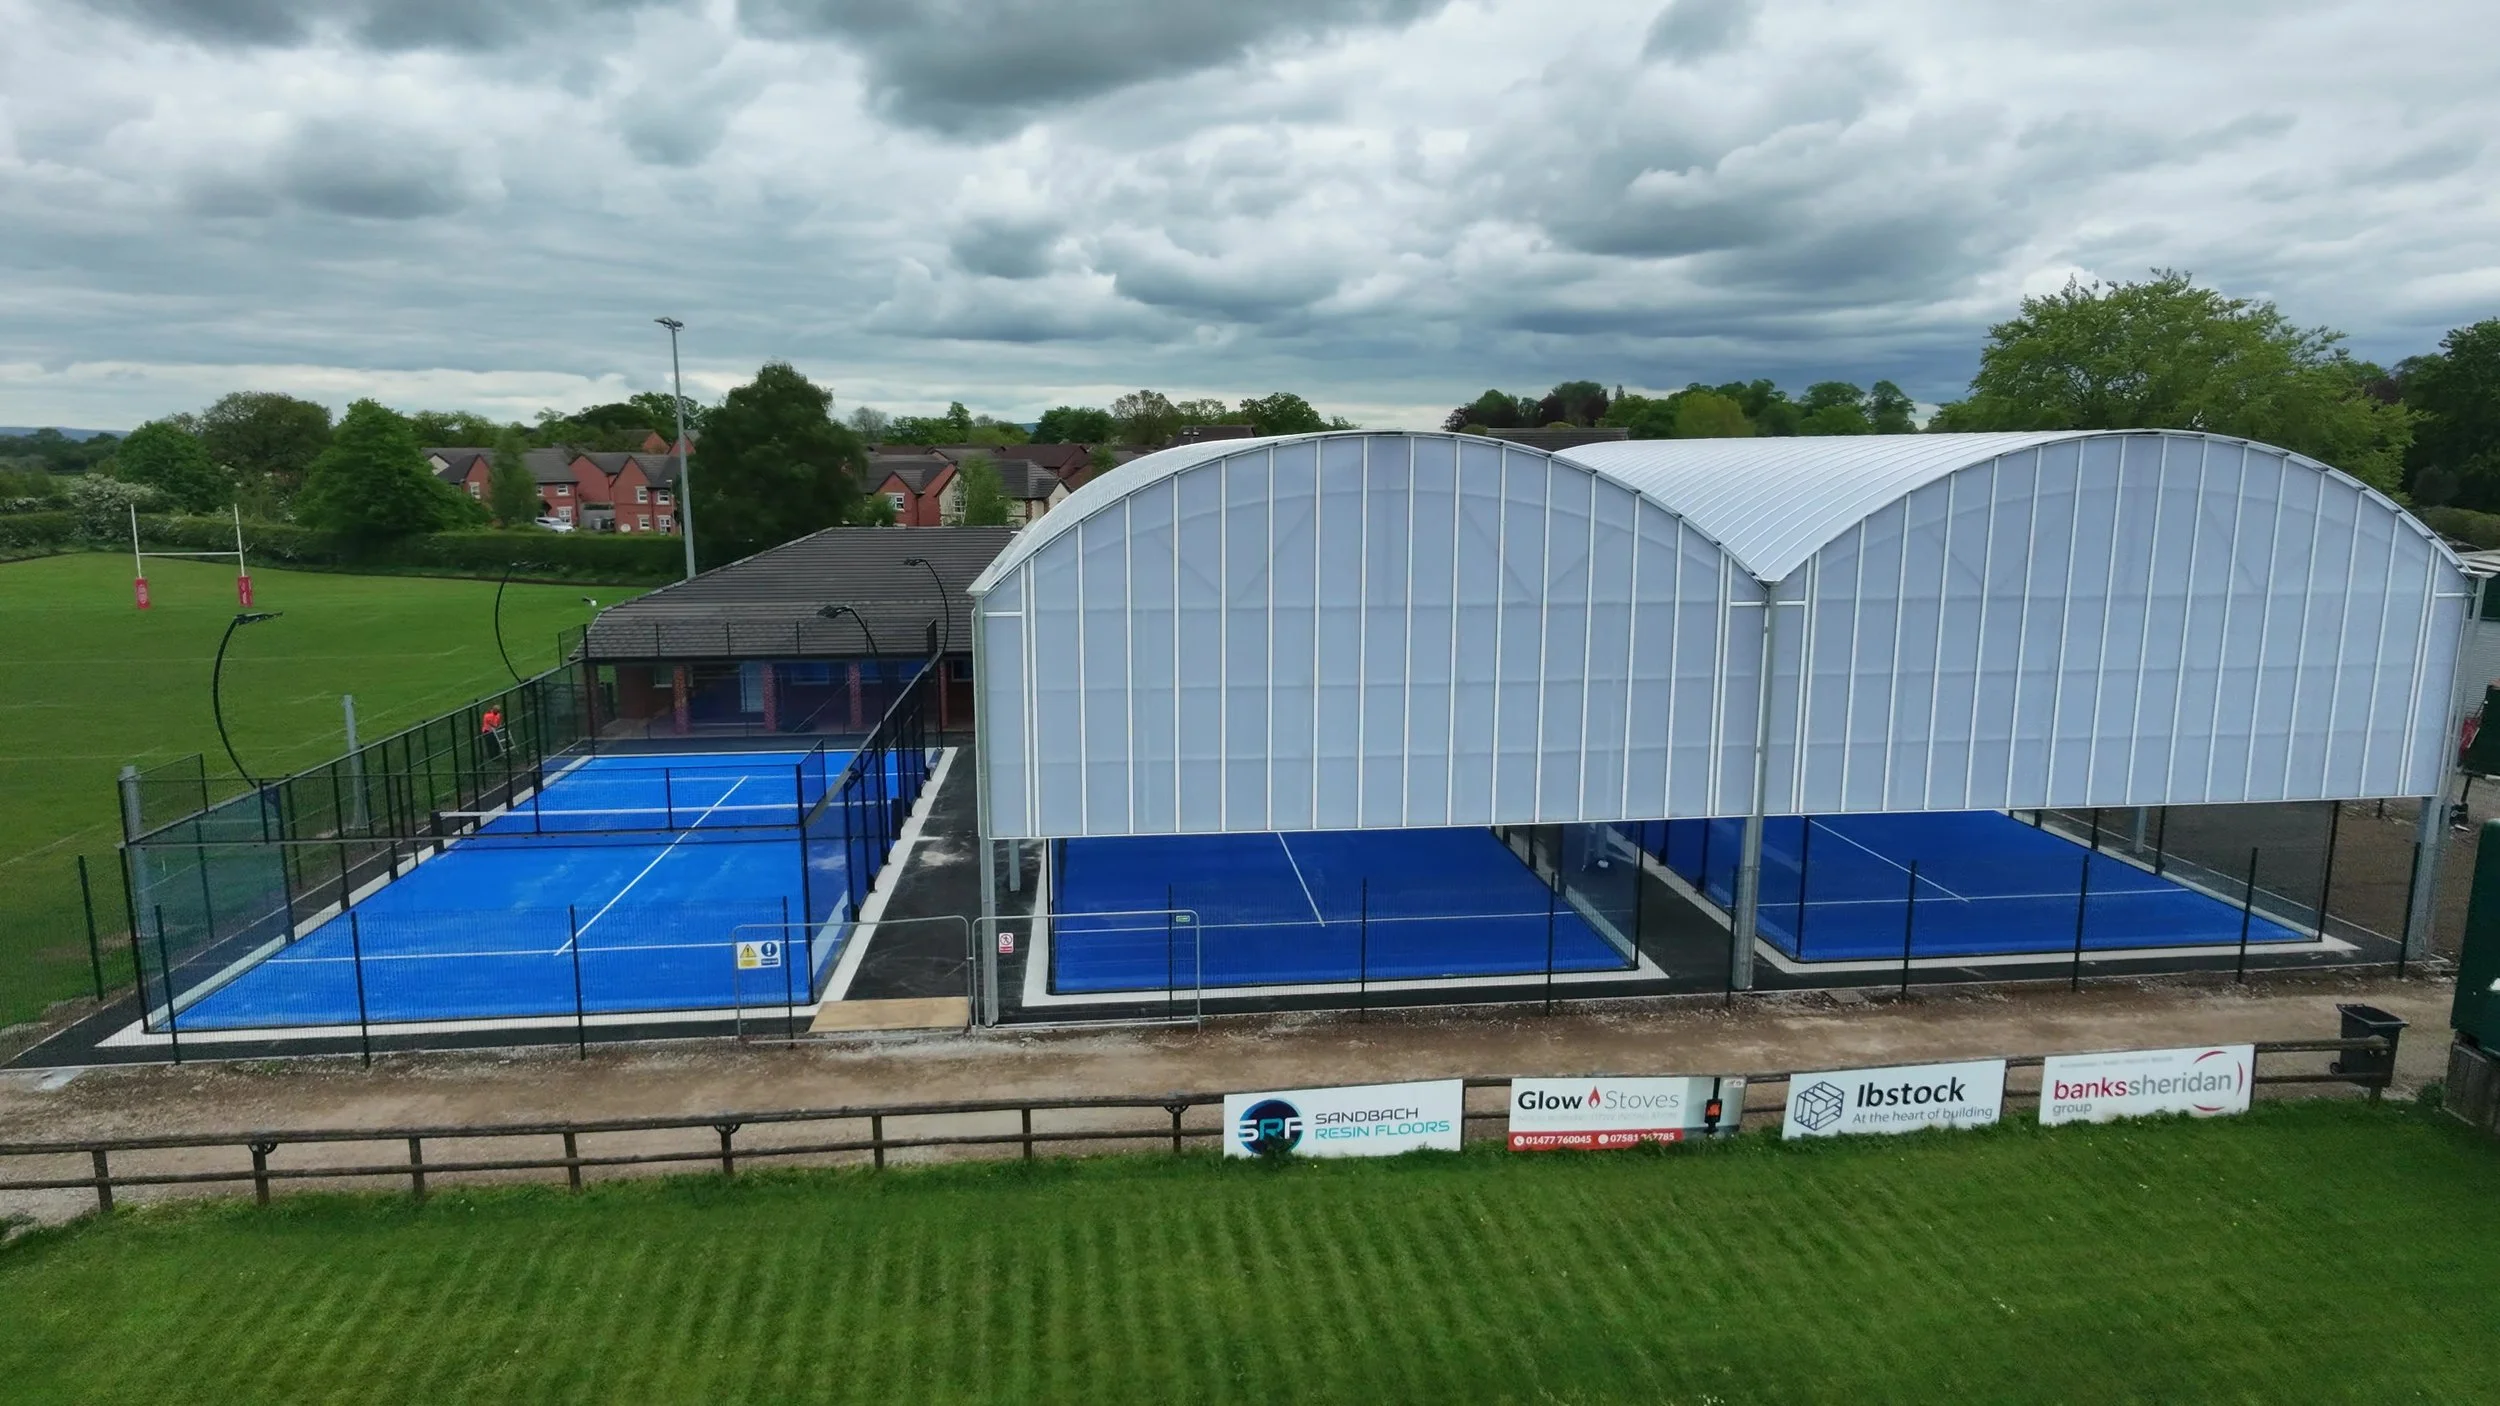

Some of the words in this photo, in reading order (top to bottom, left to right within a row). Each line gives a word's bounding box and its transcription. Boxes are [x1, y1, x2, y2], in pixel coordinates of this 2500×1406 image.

[1856, 1076, 1966, 1108] Ibstock
[2053, 1070, 2232, 1100] bankssheridan
[1517, 1090, 1583, 1110] Glow
[1604, 1090, 1680, 1110] Stoves
[2052, 1102, 2093, 1116] group
[1315, 1107, 1419, 1125] SANDBACH
[1852, 1112, 1867, 1125] At
[1869, 1110, 1890, 1123] the
[1892, 1107, 1924, 1122] heart
[1927, 1107, 1940, 1120] of
[1942, 1105, 1993, 1120] building
[1239, 1117, 1303, 1142] SRF
[1315, 1123, 1370, 1141] RESIN
[1375, 1120, 1450, 1137] FLOORS
[1556, 1135, 1592, 1144] 760045
[1610, 1134, 1639, 1142] 07581
